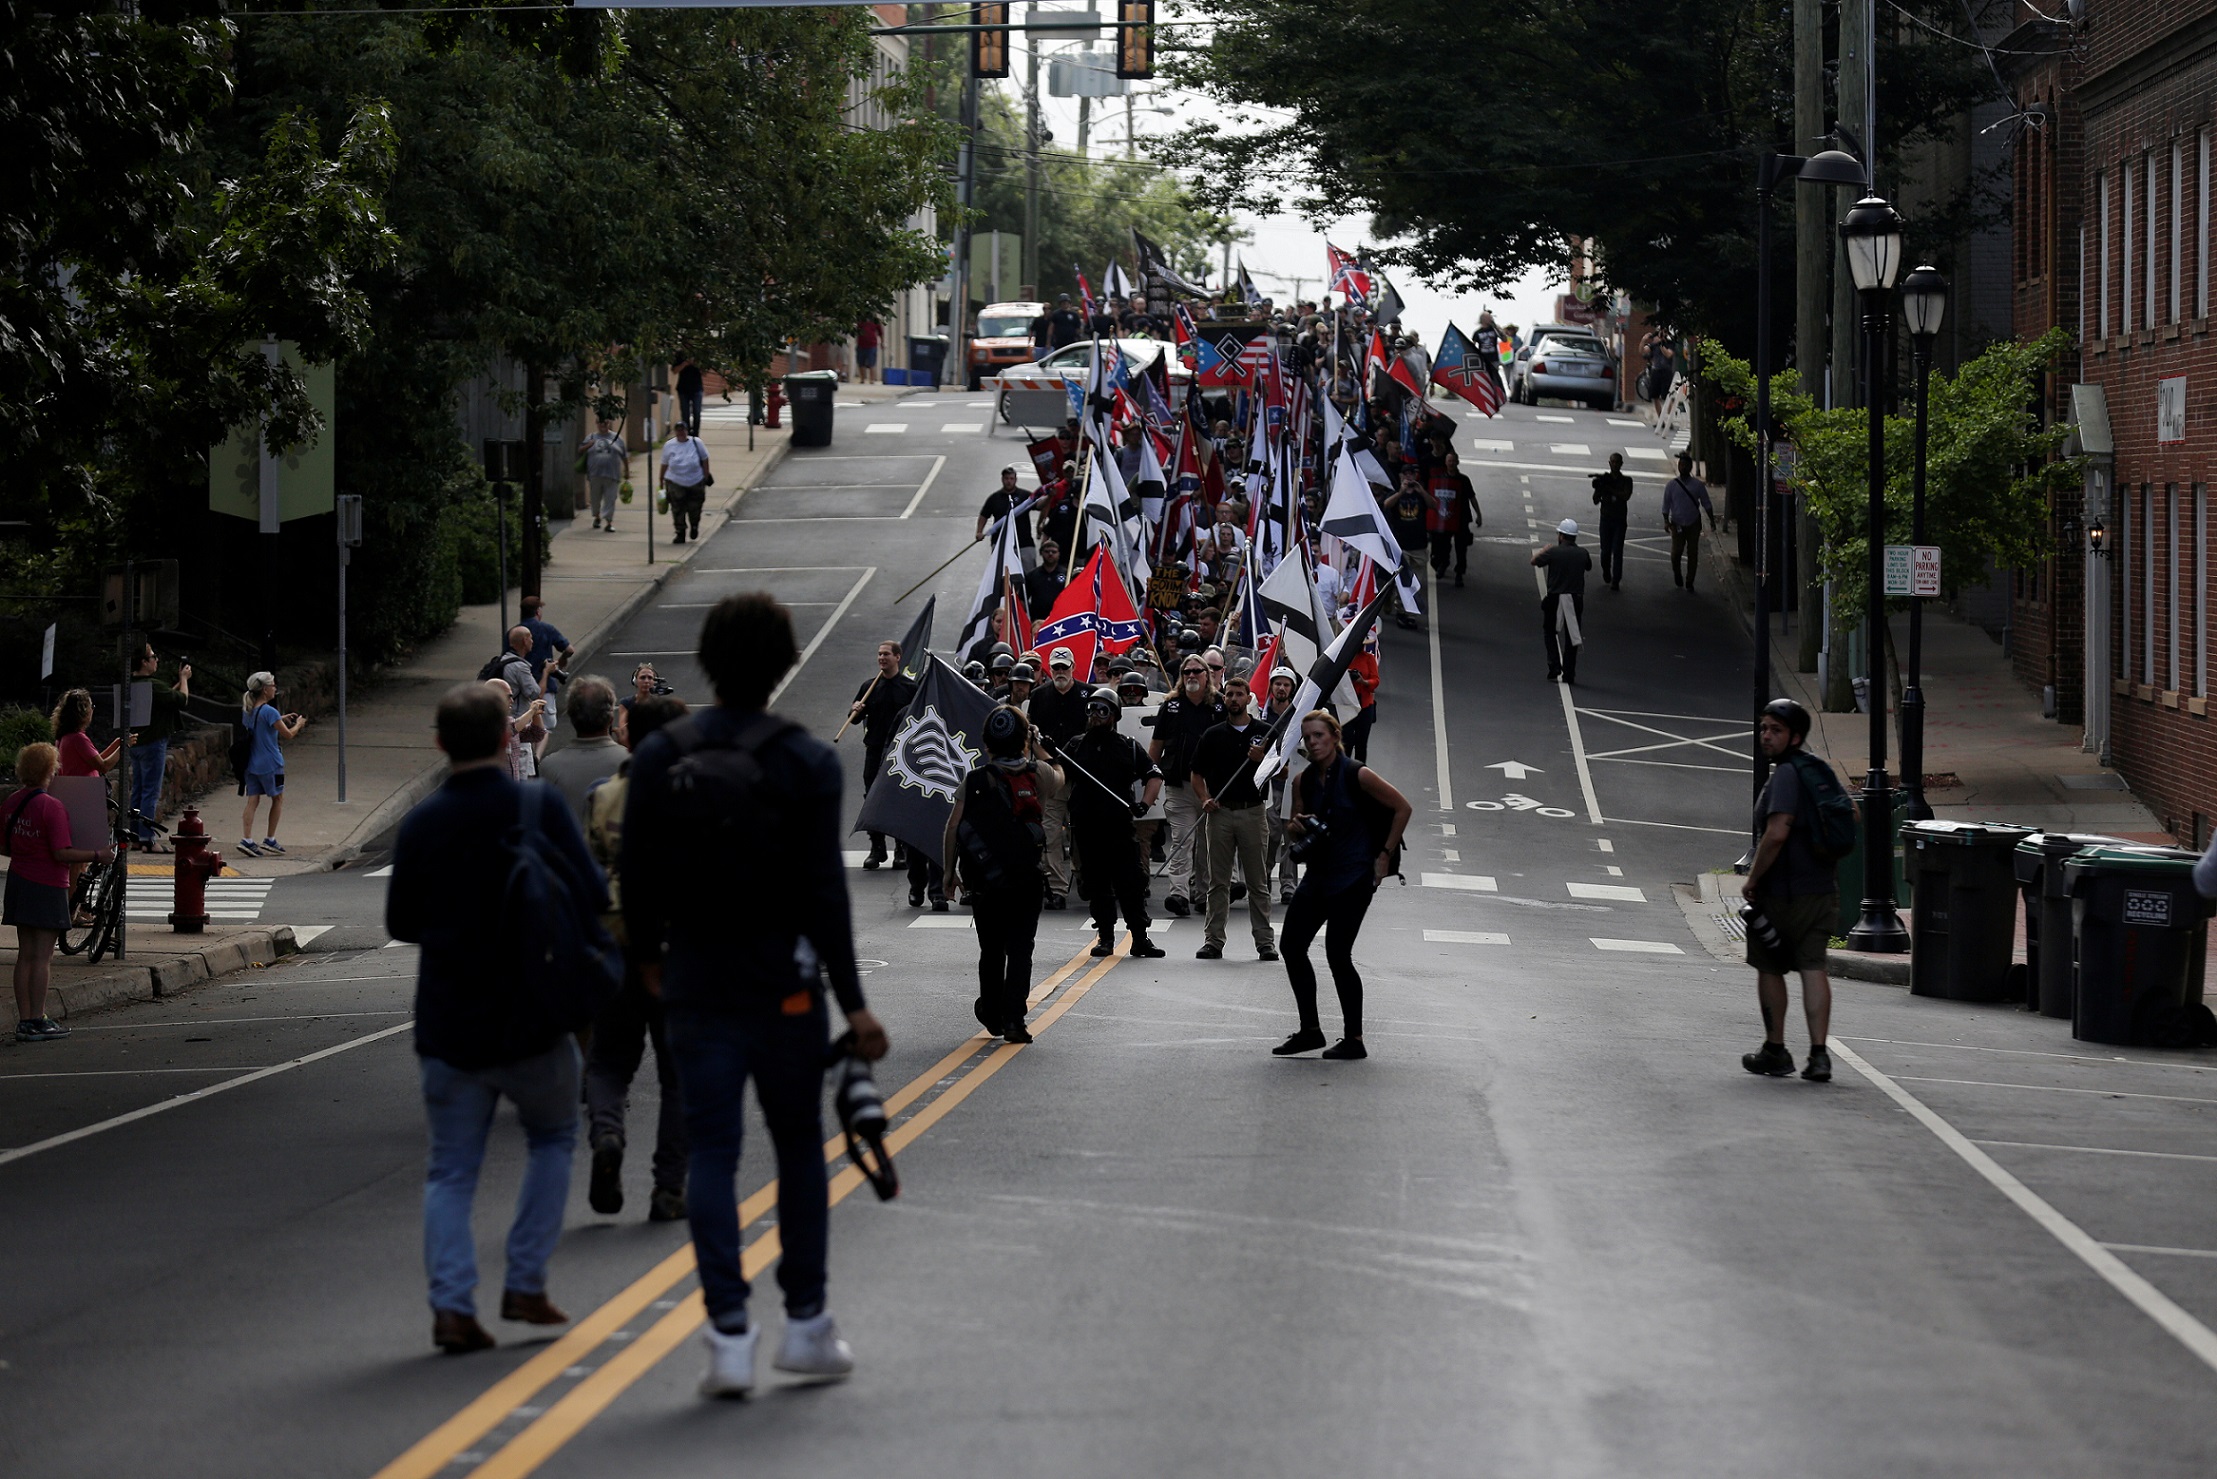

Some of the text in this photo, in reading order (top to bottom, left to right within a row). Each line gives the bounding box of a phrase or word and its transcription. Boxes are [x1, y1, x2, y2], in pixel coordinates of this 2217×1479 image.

[1922, 551, 1932, 560] NO
[1915, 562, 1938, 571] PARKING
[1155, 567, 1180, 578] THE
[1149, 591, 1181, 608] KNOW
[2127, 910, 2168, 919] RECYCLING
